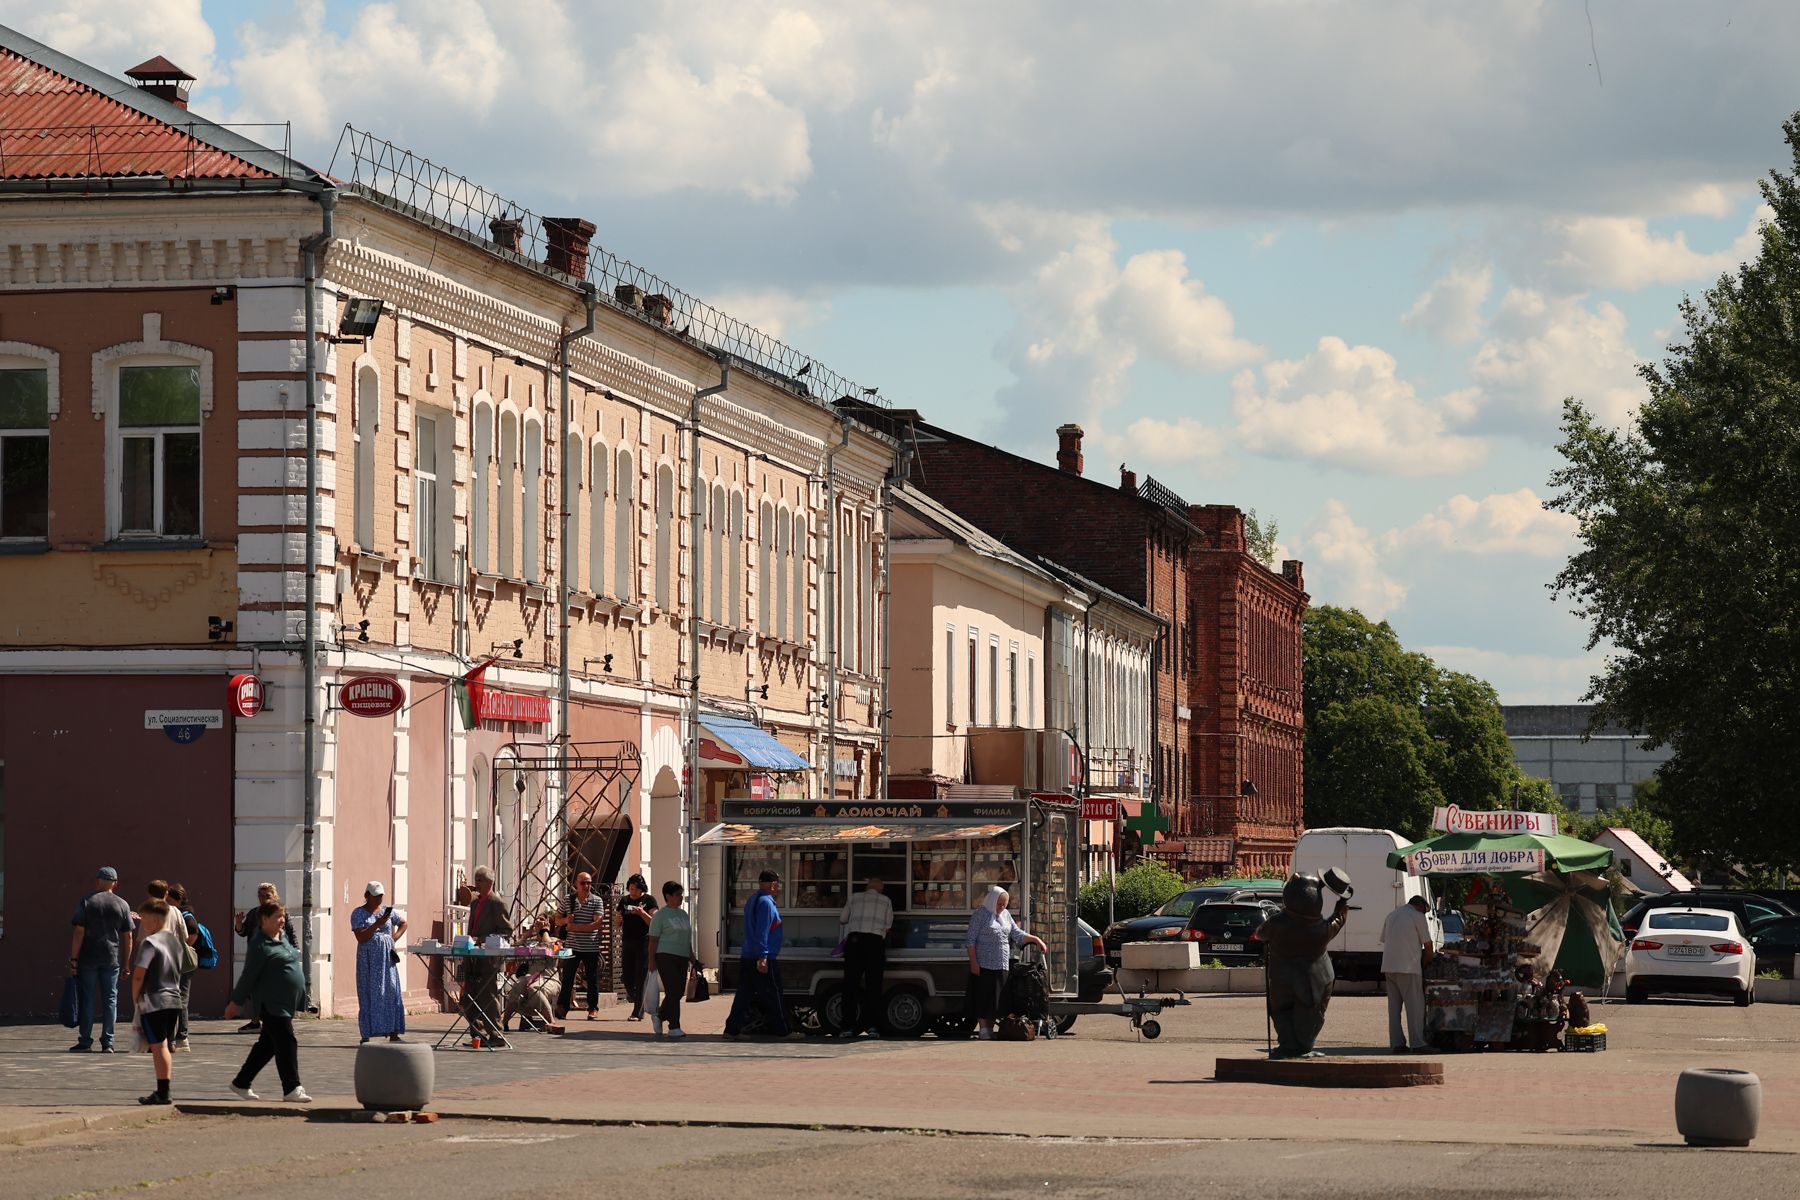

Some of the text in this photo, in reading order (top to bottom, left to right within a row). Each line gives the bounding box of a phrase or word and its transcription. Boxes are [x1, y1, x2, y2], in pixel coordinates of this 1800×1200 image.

[349, 683, 393, 700] КРАСНЫЙ
[480, 691, 513, 718] РАСНЫЙ
[159, 714, 219, 724] Социалистическая
[178, 728, 190, 740] 46
[743, 805, 1012, 818] БОБРУЙСКИЙ ДОМОЧАЙ ФИЛИАЛ
[1460, 852, 1486, 865] ДЛЯ
[1491, 851, 1535, 864] ДОБРА
